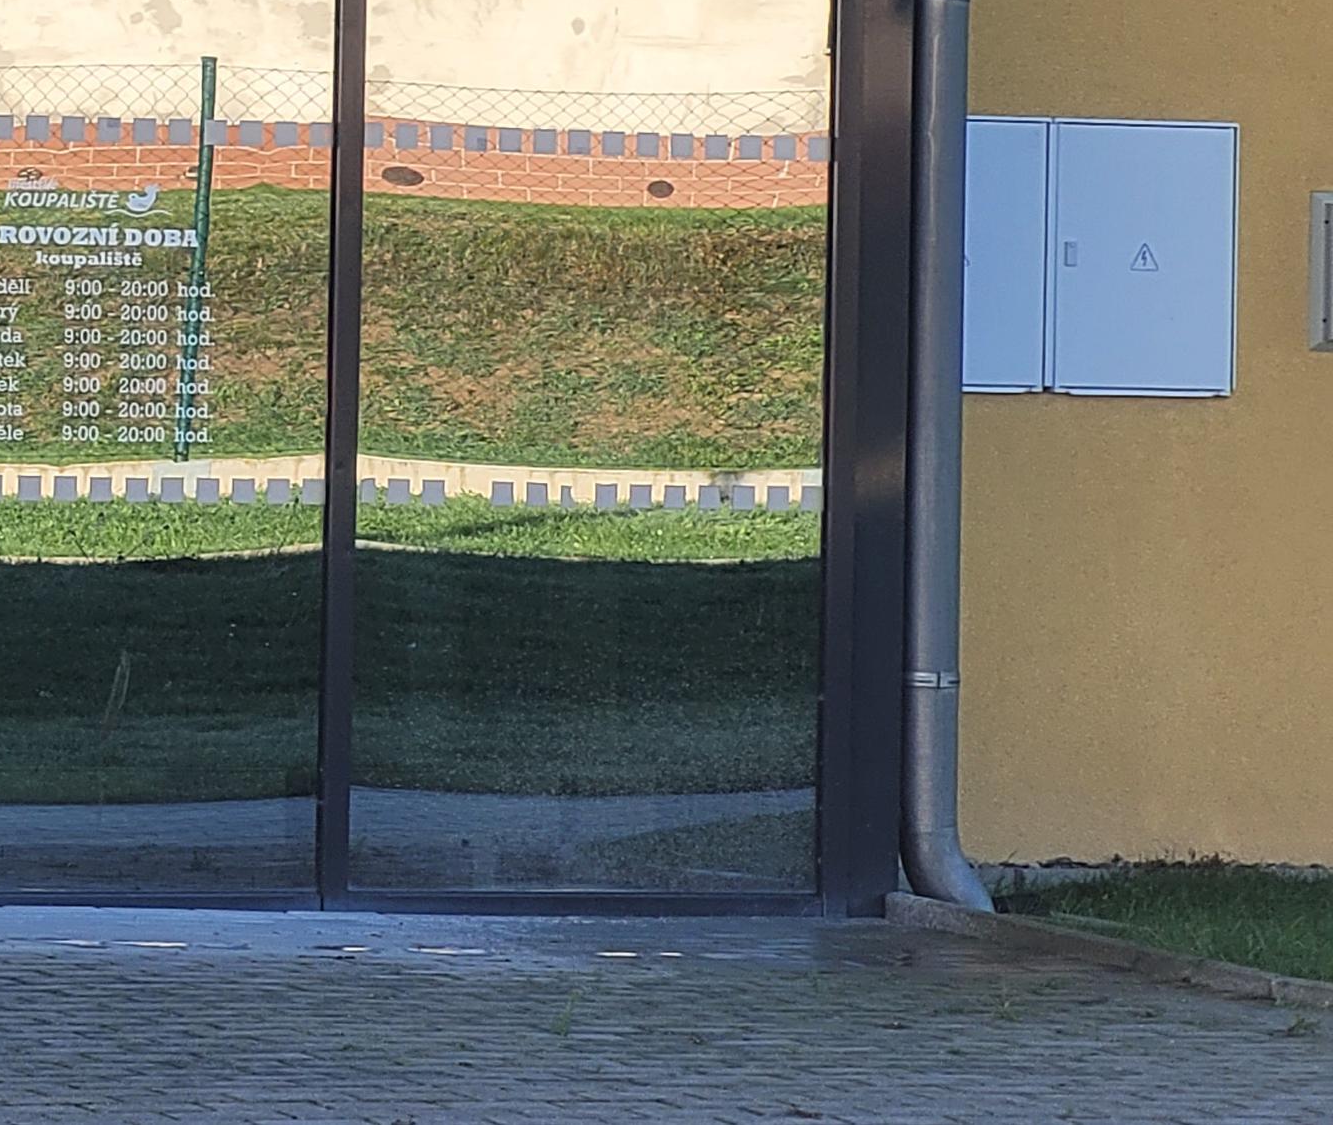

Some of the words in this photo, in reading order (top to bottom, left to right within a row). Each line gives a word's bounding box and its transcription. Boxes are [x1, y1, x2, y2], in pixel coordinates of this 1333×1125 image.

[4, 190, 120, 209] KOUPALIŠTĚ
[124, 229, 199, 248] DOBA
[35, 251, 143, 268] koupaliště
[65, 279, 102, 295] 9:00
[120, 280, 169, 297] 20:00
[177, 282, 216, 298] hod.
[64, 303, 102, 320] 9:00
[120, 305, 168, 322] 20:00
[176, 307, 215, 322] hod.
[63, 328, 101, 344] 9:00
[119, 329, 167, 346] 20:00
[176, 330, 215, 346] hod.
[63, 352, 101, 368] 9:00
[119, 353, 167, 369] 20:00
[176, 354, 214, 370] hod.
[63, 377, 100, 393] 9:00
[119, 378, 166, 394] 20:00
[175, 379, 214, 395] hod.
[62, 401, 100, 417] 9:00
[118, 402, 166, 418] 20:00
[175, 403, 214, 419] hod.
[62, 425, 99, 441] 9:00
[117, 426, 165, 442] 20:00
[174, 427, 213, 443] hod.
